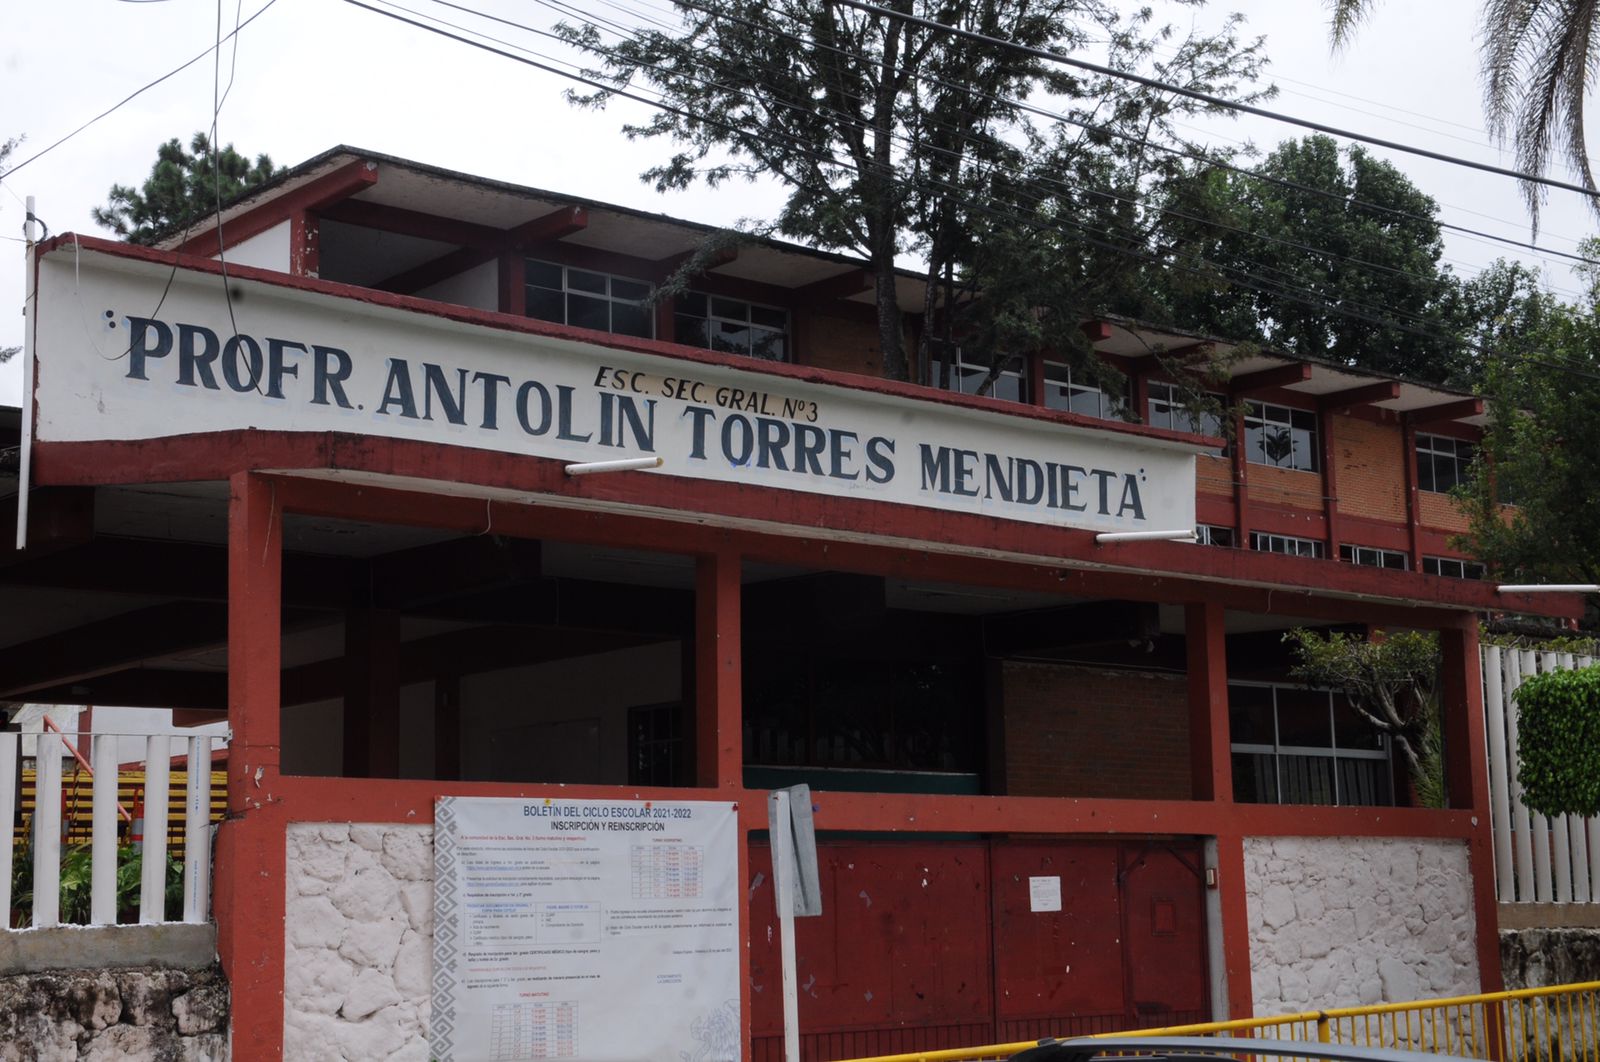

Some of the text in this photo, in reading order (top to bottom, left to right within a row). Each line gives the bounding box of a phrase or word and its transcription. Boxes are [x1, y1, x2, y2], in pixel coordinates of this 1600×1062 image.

[594, 366, 648, 394] ESC.
[661, 377, 707, 404] SEC.
[716, 387, 775, 416] GRAL.
[376, 357, 656, 453] ANTOLIN
[683, 405, 896, 484] TORRES
[564, 806, 581, 817] DEL
[583, 806, 609, 818] CICLO
[611, 807, 651, 819] ESCOLAR
[653, 808, 692, 819] 2021-2022
[601, 821, 606, 831] Y
